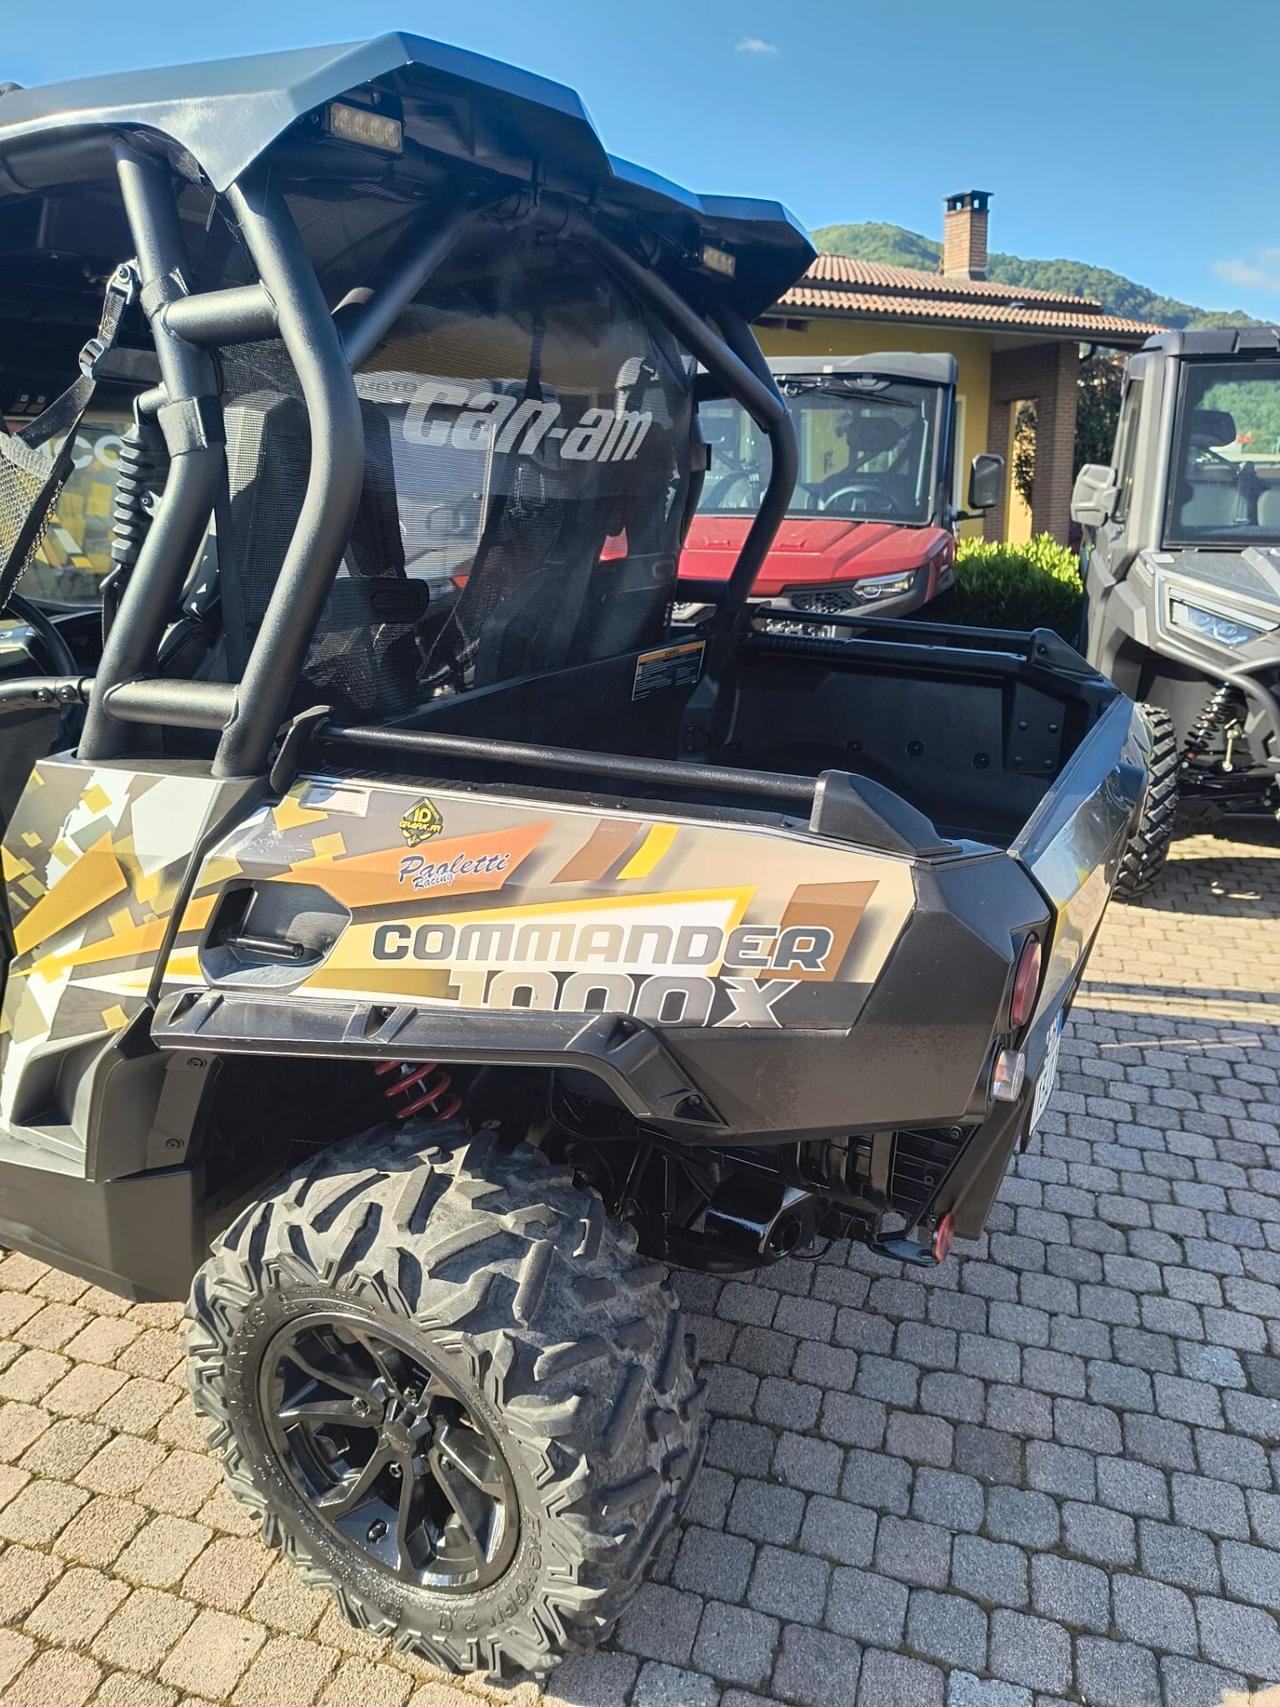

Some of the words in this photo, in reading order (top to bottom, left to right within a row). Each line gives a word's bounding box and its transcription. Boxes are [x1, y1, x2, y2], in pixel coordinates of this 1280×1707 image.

[413, 807, 432, 824] ID
[398, 854, 510, 883] Paoletti
[413, 872, 455, 891] Racing
[372, 923, 836, 973] COMMANDER
[447, 969, 802, 1029] 1000X
